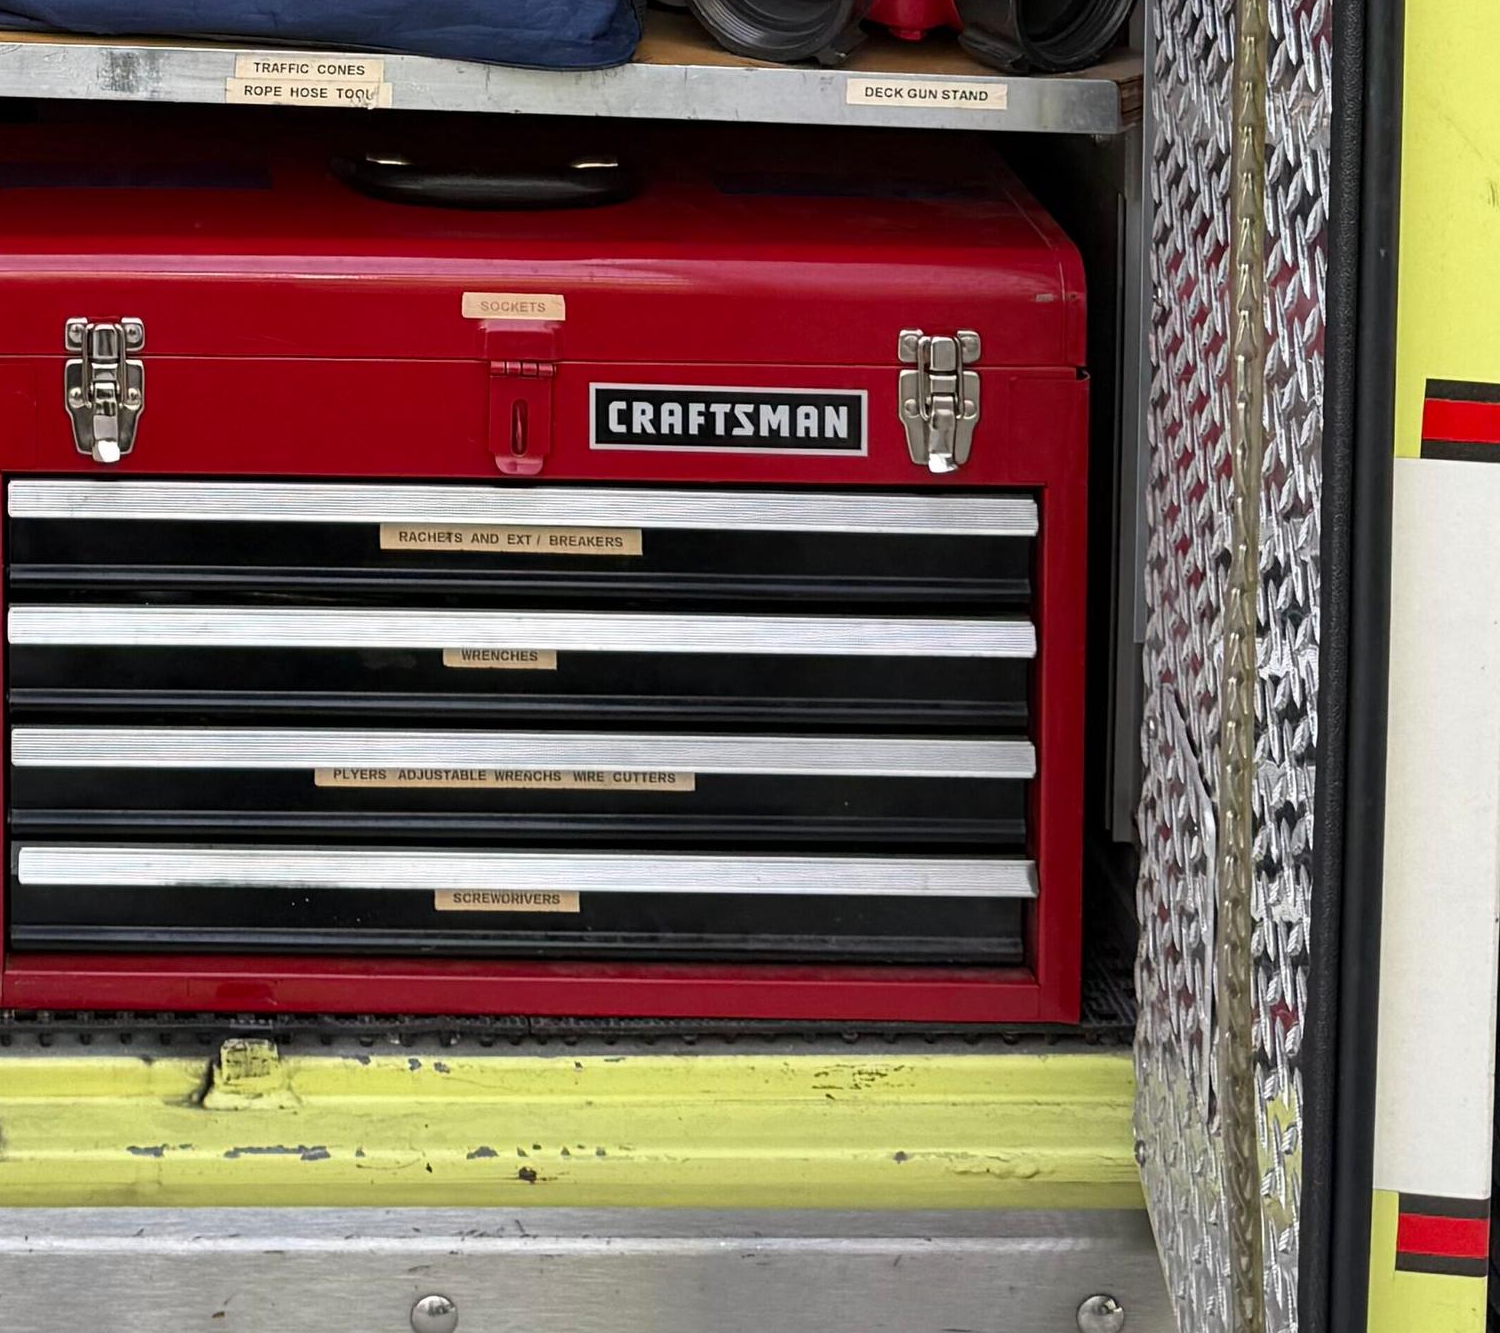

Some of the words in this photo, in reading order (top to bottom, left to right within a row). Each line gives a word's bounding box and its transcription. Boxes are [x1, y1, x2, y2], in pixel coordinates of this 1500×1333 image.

[253, 62, 309, 75] TRAFFIC
[316, 64, 366, 76] CONES
[244, 85, 283, 97] ROPE
[289, 86, 328, 99] HOSE
[864, 86, 904, 99] DECK
[907, 88, 938, 100] GUN
[941, 89, 989, 102] STAND
[480, 300, 547, 313] SOCKETS
[608, 400, 849, 439] CRAFTSMAN
[398, 531, 463, 544] RACHETS
[470, 532, 500, 545] AND
[506, 533, 532, 546] EXT
[548, 535, 624, 547] BREAKERS
[460, 649, 539, 662] WRENCHES
[333, 768, 387, 780] PLYERS
[397, 769, 487, 782] ADJUSTABLE
[494, 770, 562, 782] WRENCHS
[572, 771, 605, 783] WIRE
[612, 771, 676, 784] CUTTERS
[452, 892, 561, 905] SCREWDRIVERS
